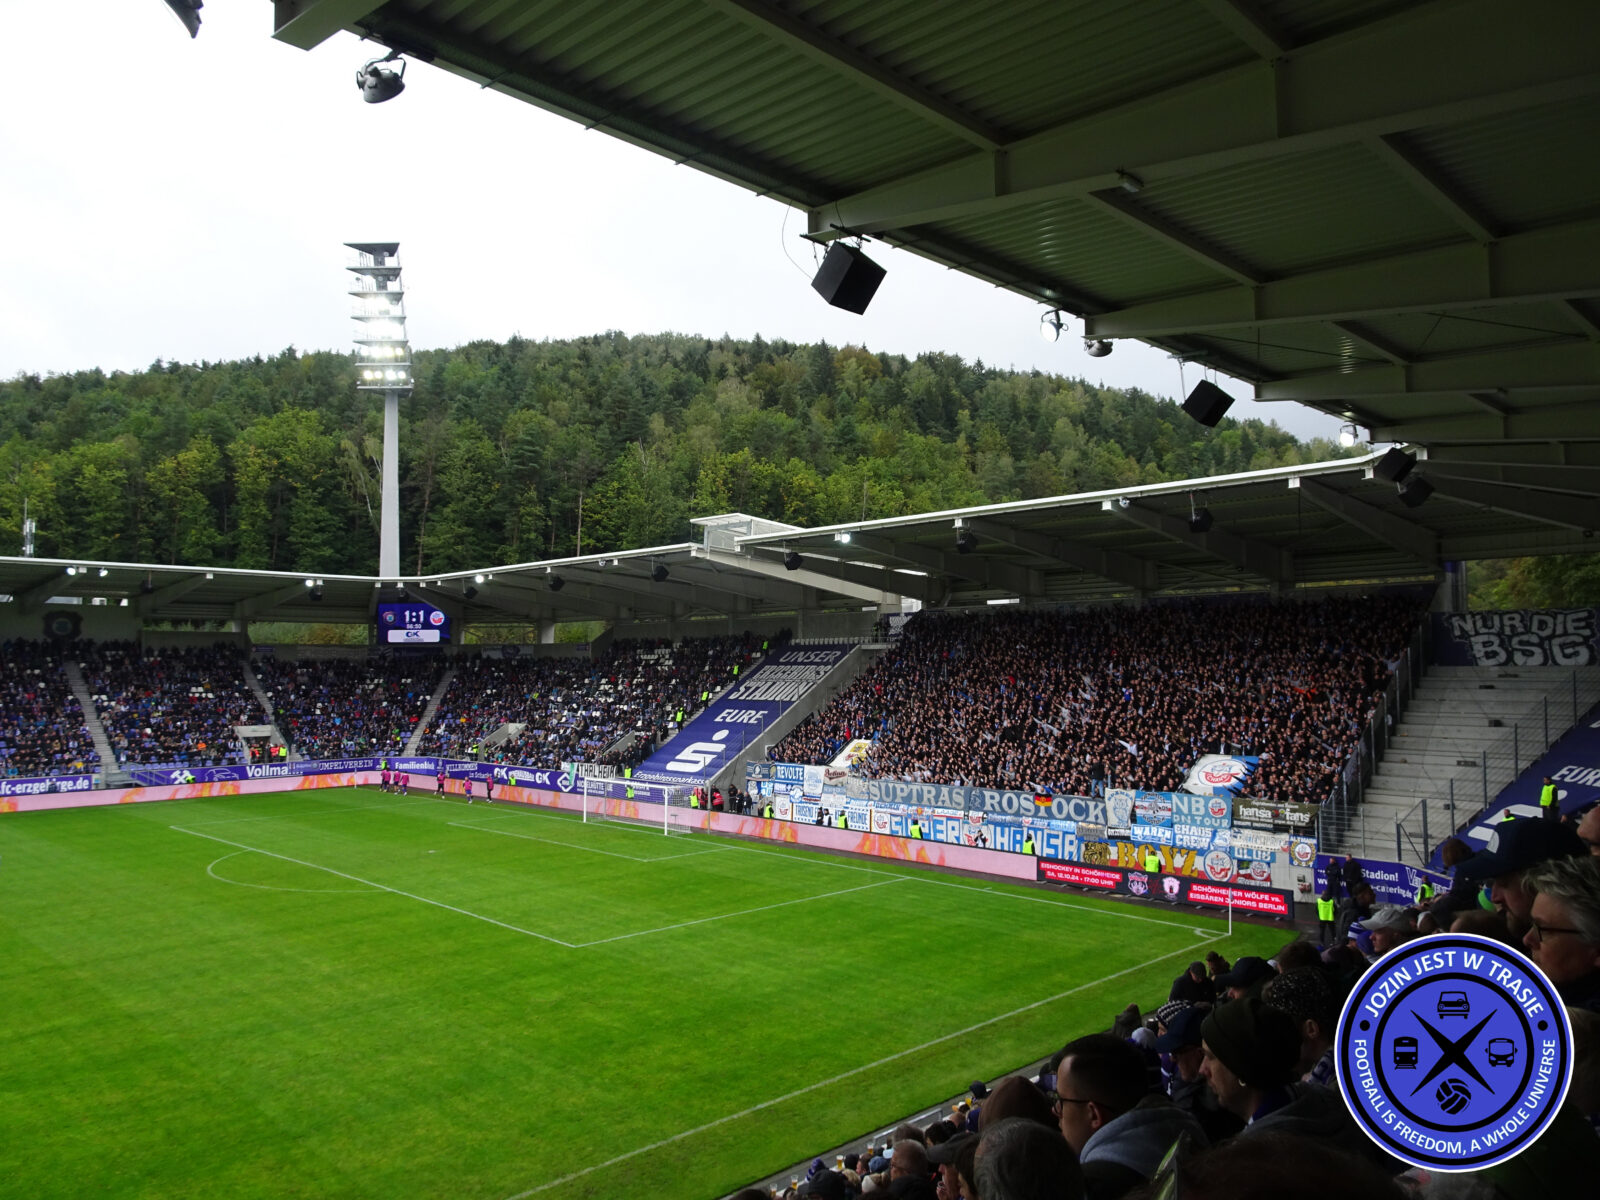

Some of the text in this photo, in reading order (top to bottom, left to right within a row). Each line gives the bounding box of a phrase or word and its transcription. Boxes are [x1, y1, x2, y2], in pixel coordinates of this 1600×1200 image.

[404, 610, 424, 623] 1:1
[1452, 611, 1592, 637] NUR DIE
[1470, 632, 1590, 666] BSG
[779, 651, 841, 663] UNSER
[728, 681, 817, 701] STADION
[714, 709, 768, 724] EURE
[246, 765, 303, 778] Vollma
[319, 760, 373, 771] UMPELVEREIN
[535, 772, 551, 785] GK
[776, 766, 804, 780] REVOLTE
[869, 781, 965, 810] SUPTRAS
[1172, 795, 1206, 815] NB
[1240, 805, 1271, 819] hansa
[1285, 808, 1310, 823] fans
[1194, 816, 1229, 827] TOUR
[1134, 827, 1171, 839] WAREN
[1174, 824, 1212, 836] CHAOS
[890, 814, 961, 843] SUPER
[995, 826, 1078, 861] HANSA
[1176, 835, 1211, 848] CREW
[1116, 842, 1198, 877] BOYZ
[1041, 862, 1073, 872] EISHOCKEY
[1081, 868, 1121, 879] SCHÖNHEIDE
[1361, 868, 1398, 882] Stadion!
[1084, 876, 1099, 884] 17:00
[1189, 893, 1224, 903] EISBÄREN
[1258, 903, 1285, 911] BERLIN
[1244, 890, 1269, 901] WÖLFE
